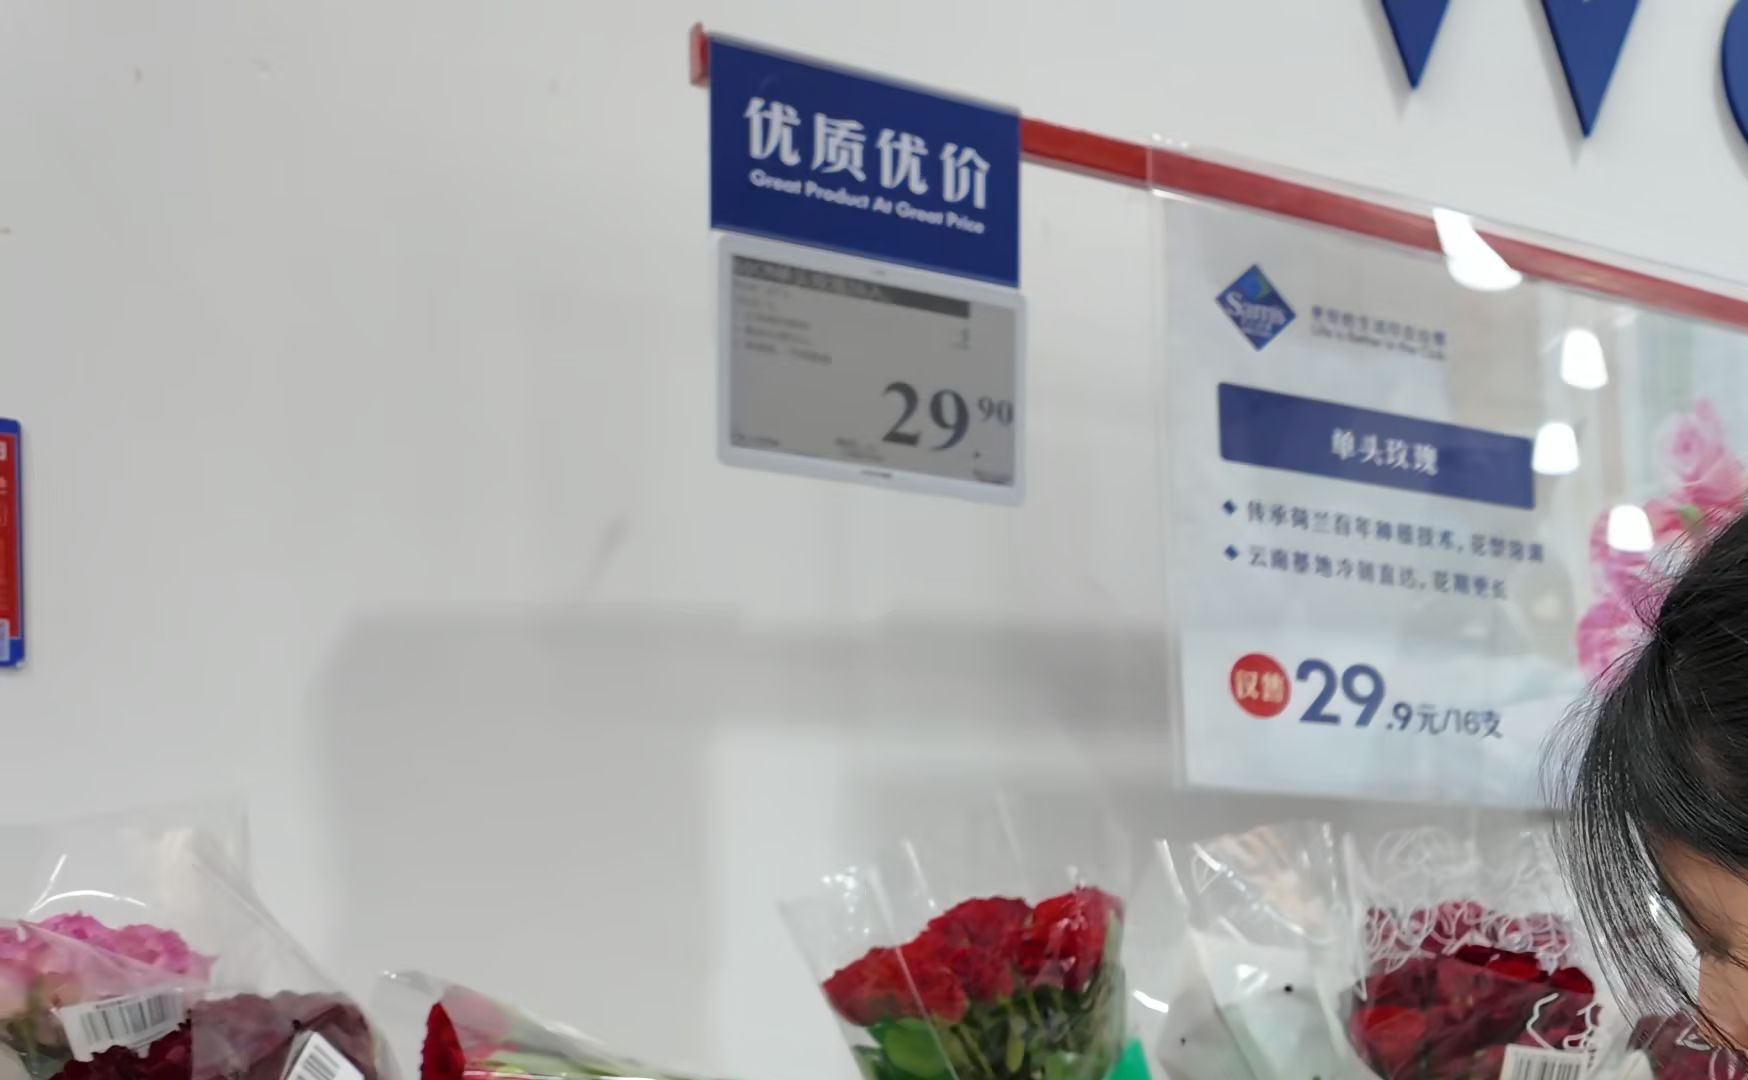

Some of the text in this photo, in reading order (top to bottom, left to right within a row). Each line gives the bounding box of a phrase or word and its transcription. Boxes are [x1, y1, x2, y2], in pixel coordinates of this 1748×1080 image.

[744, 96, 991, 210] 优质优价
[750, 168, 986, 234] Great Product At Great Price
[1331, 428, 1439, 477] 单头玫瑰
[1235, 668, 1287, 703] 仅售
